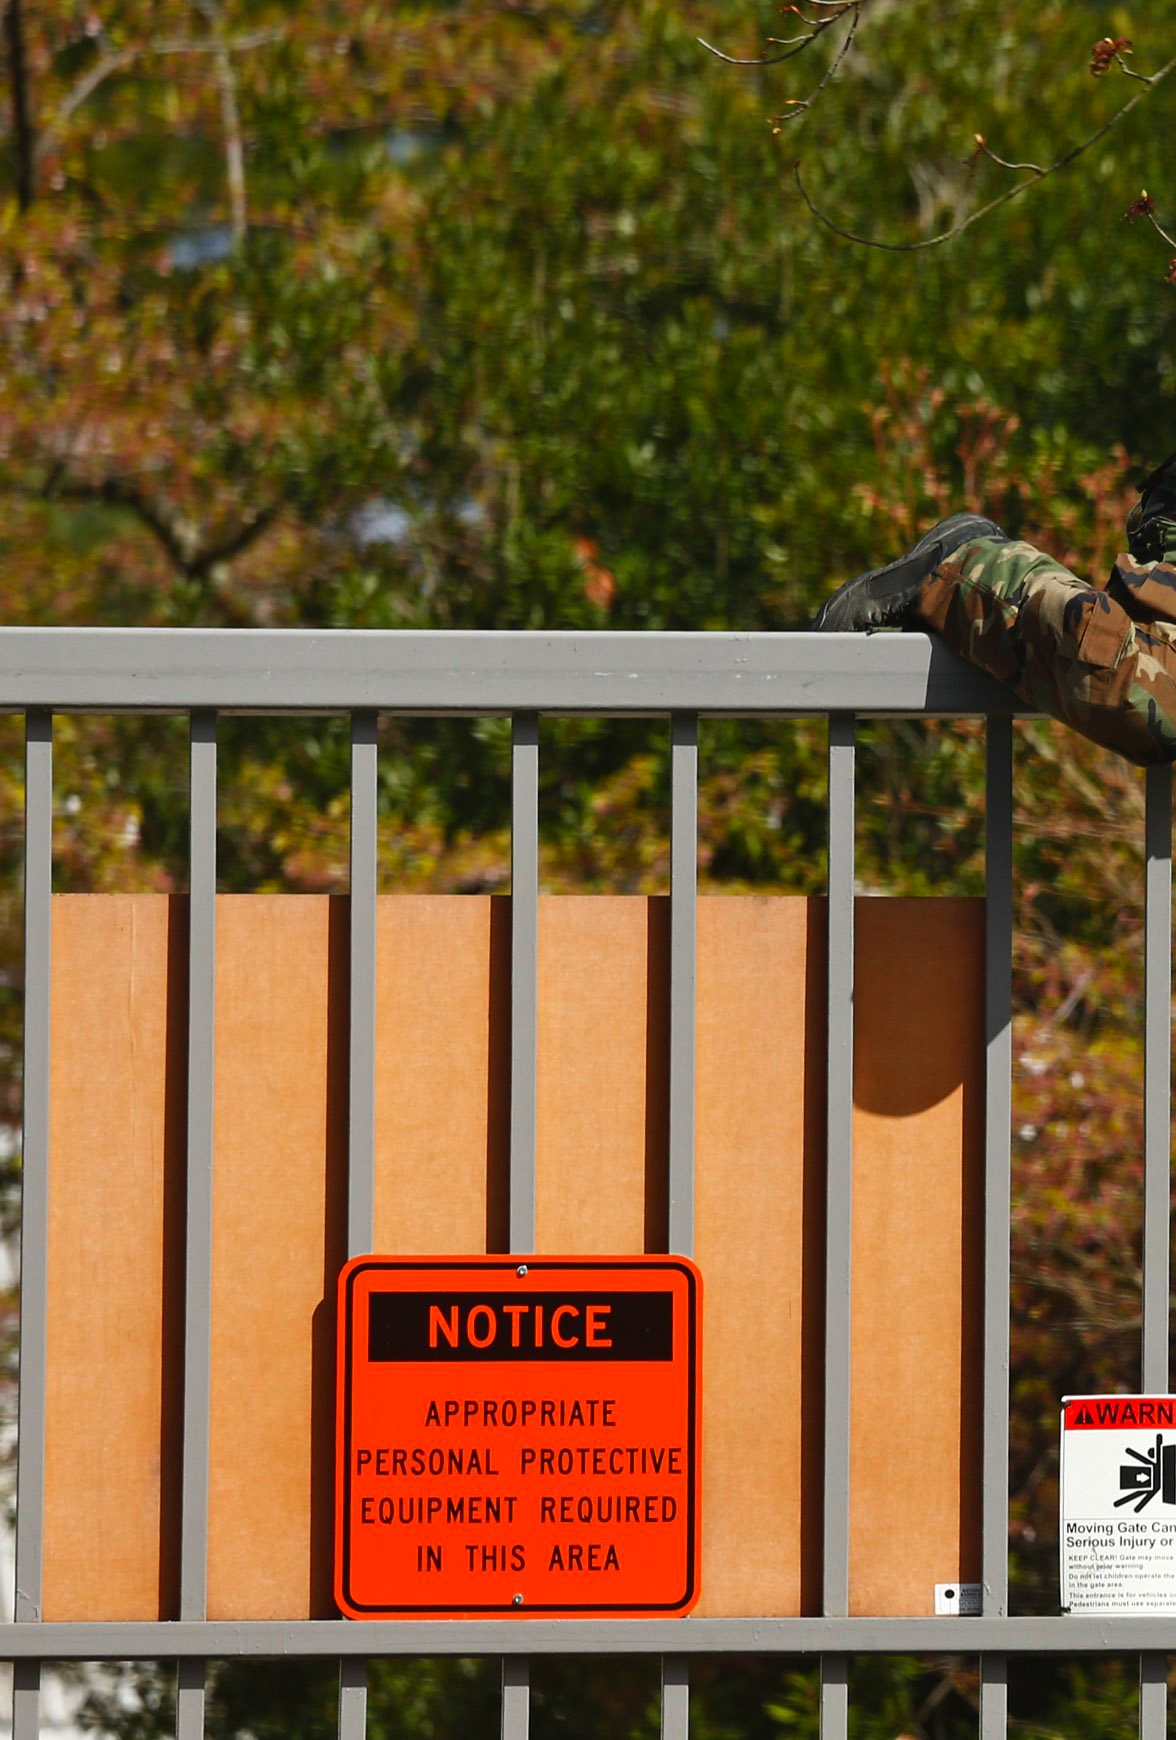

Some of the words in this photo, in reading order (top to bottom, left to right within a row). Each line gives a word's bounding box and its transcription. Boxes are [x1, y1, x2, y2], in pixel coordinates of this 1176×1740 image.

[428, 1304, 613, 1348] NOTICE
[424, 1400, 617, 1427] APPROPRIATE
[356, 1448, 499, 1476] PERSONAL
[520, 1447, 682, 1475] PROTECTIVE
[360, 1497, 518, 1525] EQUIPMENT
[540, 1496, 678, 1524] REQUIRED
[1066, 1522, 1113, 1536] Moving
[1117, 1522, 1147, 1533] Gate
[1151, 1521, 1176, 1533] Can
[1066, 1536, 1115, 1547] Serious
[1119, 1535, 1156, 1549] Injury
[1160, 1538, 1174, 1546] or
[417, 1545, 442, 1572] IN
[465, 1545, 526, 1571] THIS
[548, 1544, 620, 1571] AREA
[1134, 1573, 1162, 1581] operate
